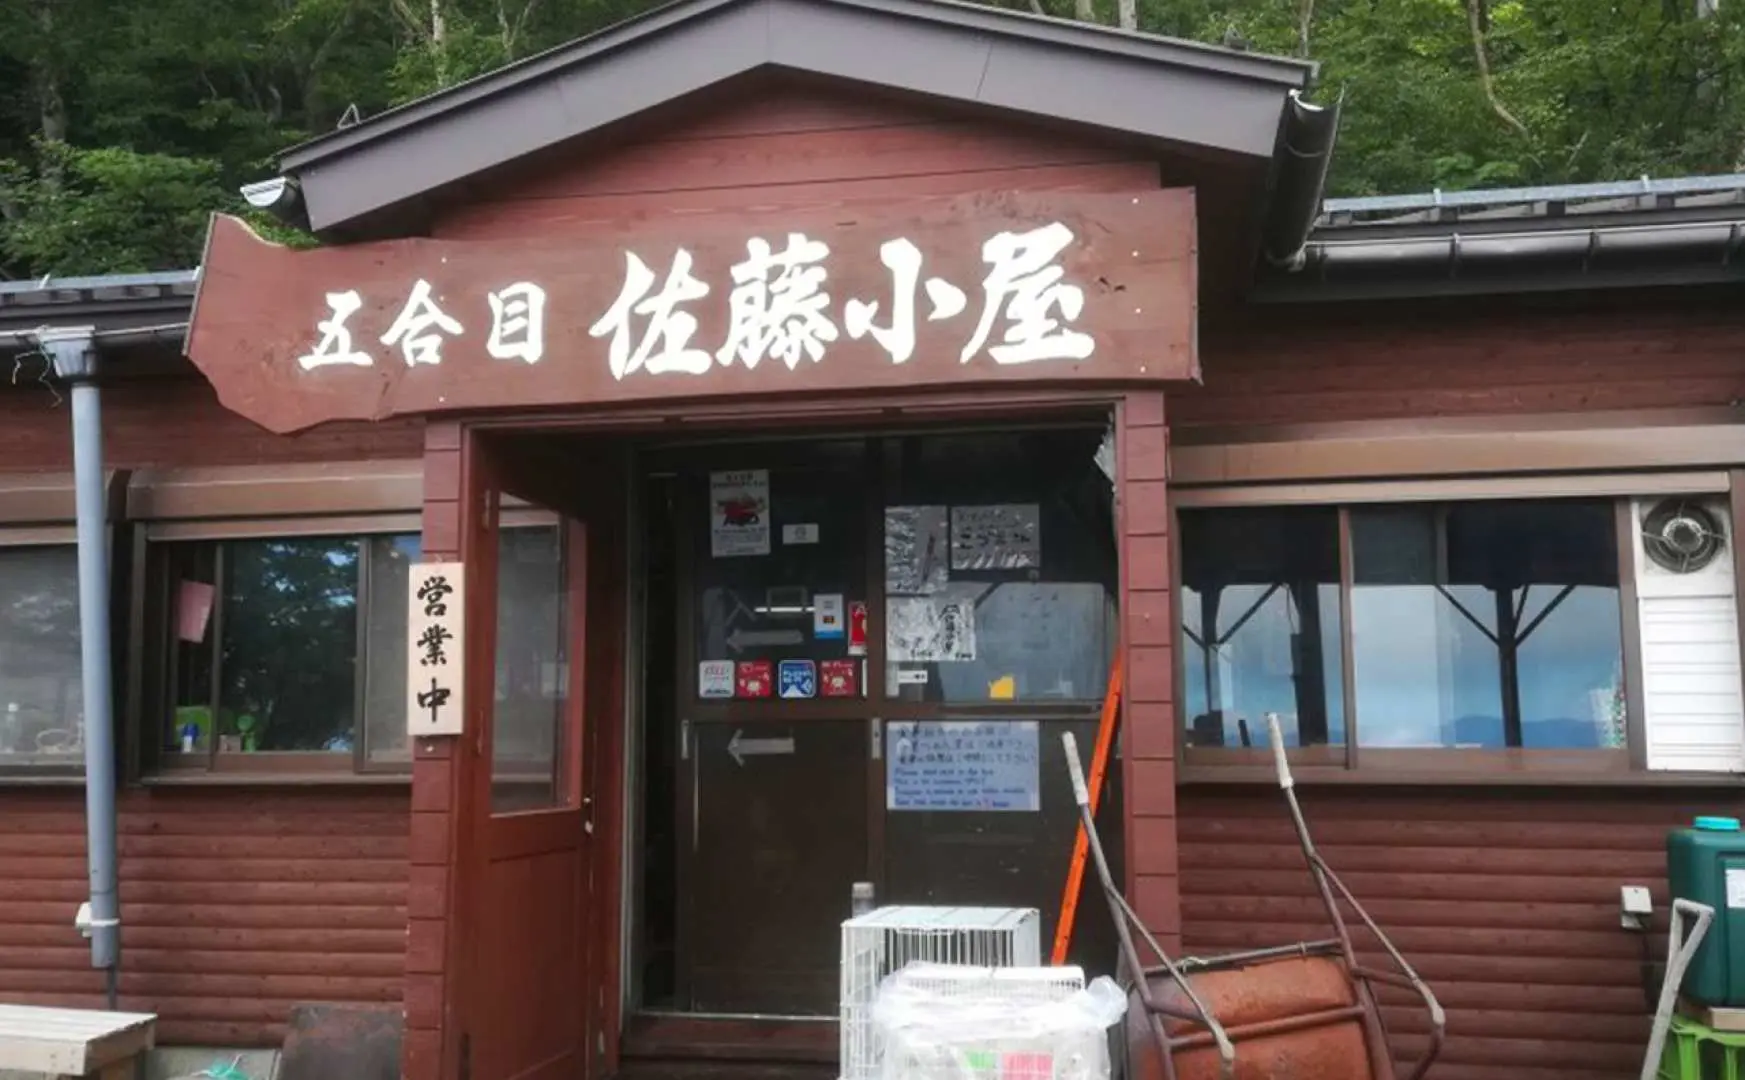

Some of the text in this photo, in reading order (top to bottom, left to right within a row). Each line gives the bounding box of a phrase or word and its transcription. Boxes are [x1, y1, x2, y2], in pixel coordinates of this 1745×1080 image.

[298, 221, 1096, 381] 五合目 佐藤小屋
[416, 576, 453, 722] 営業中
